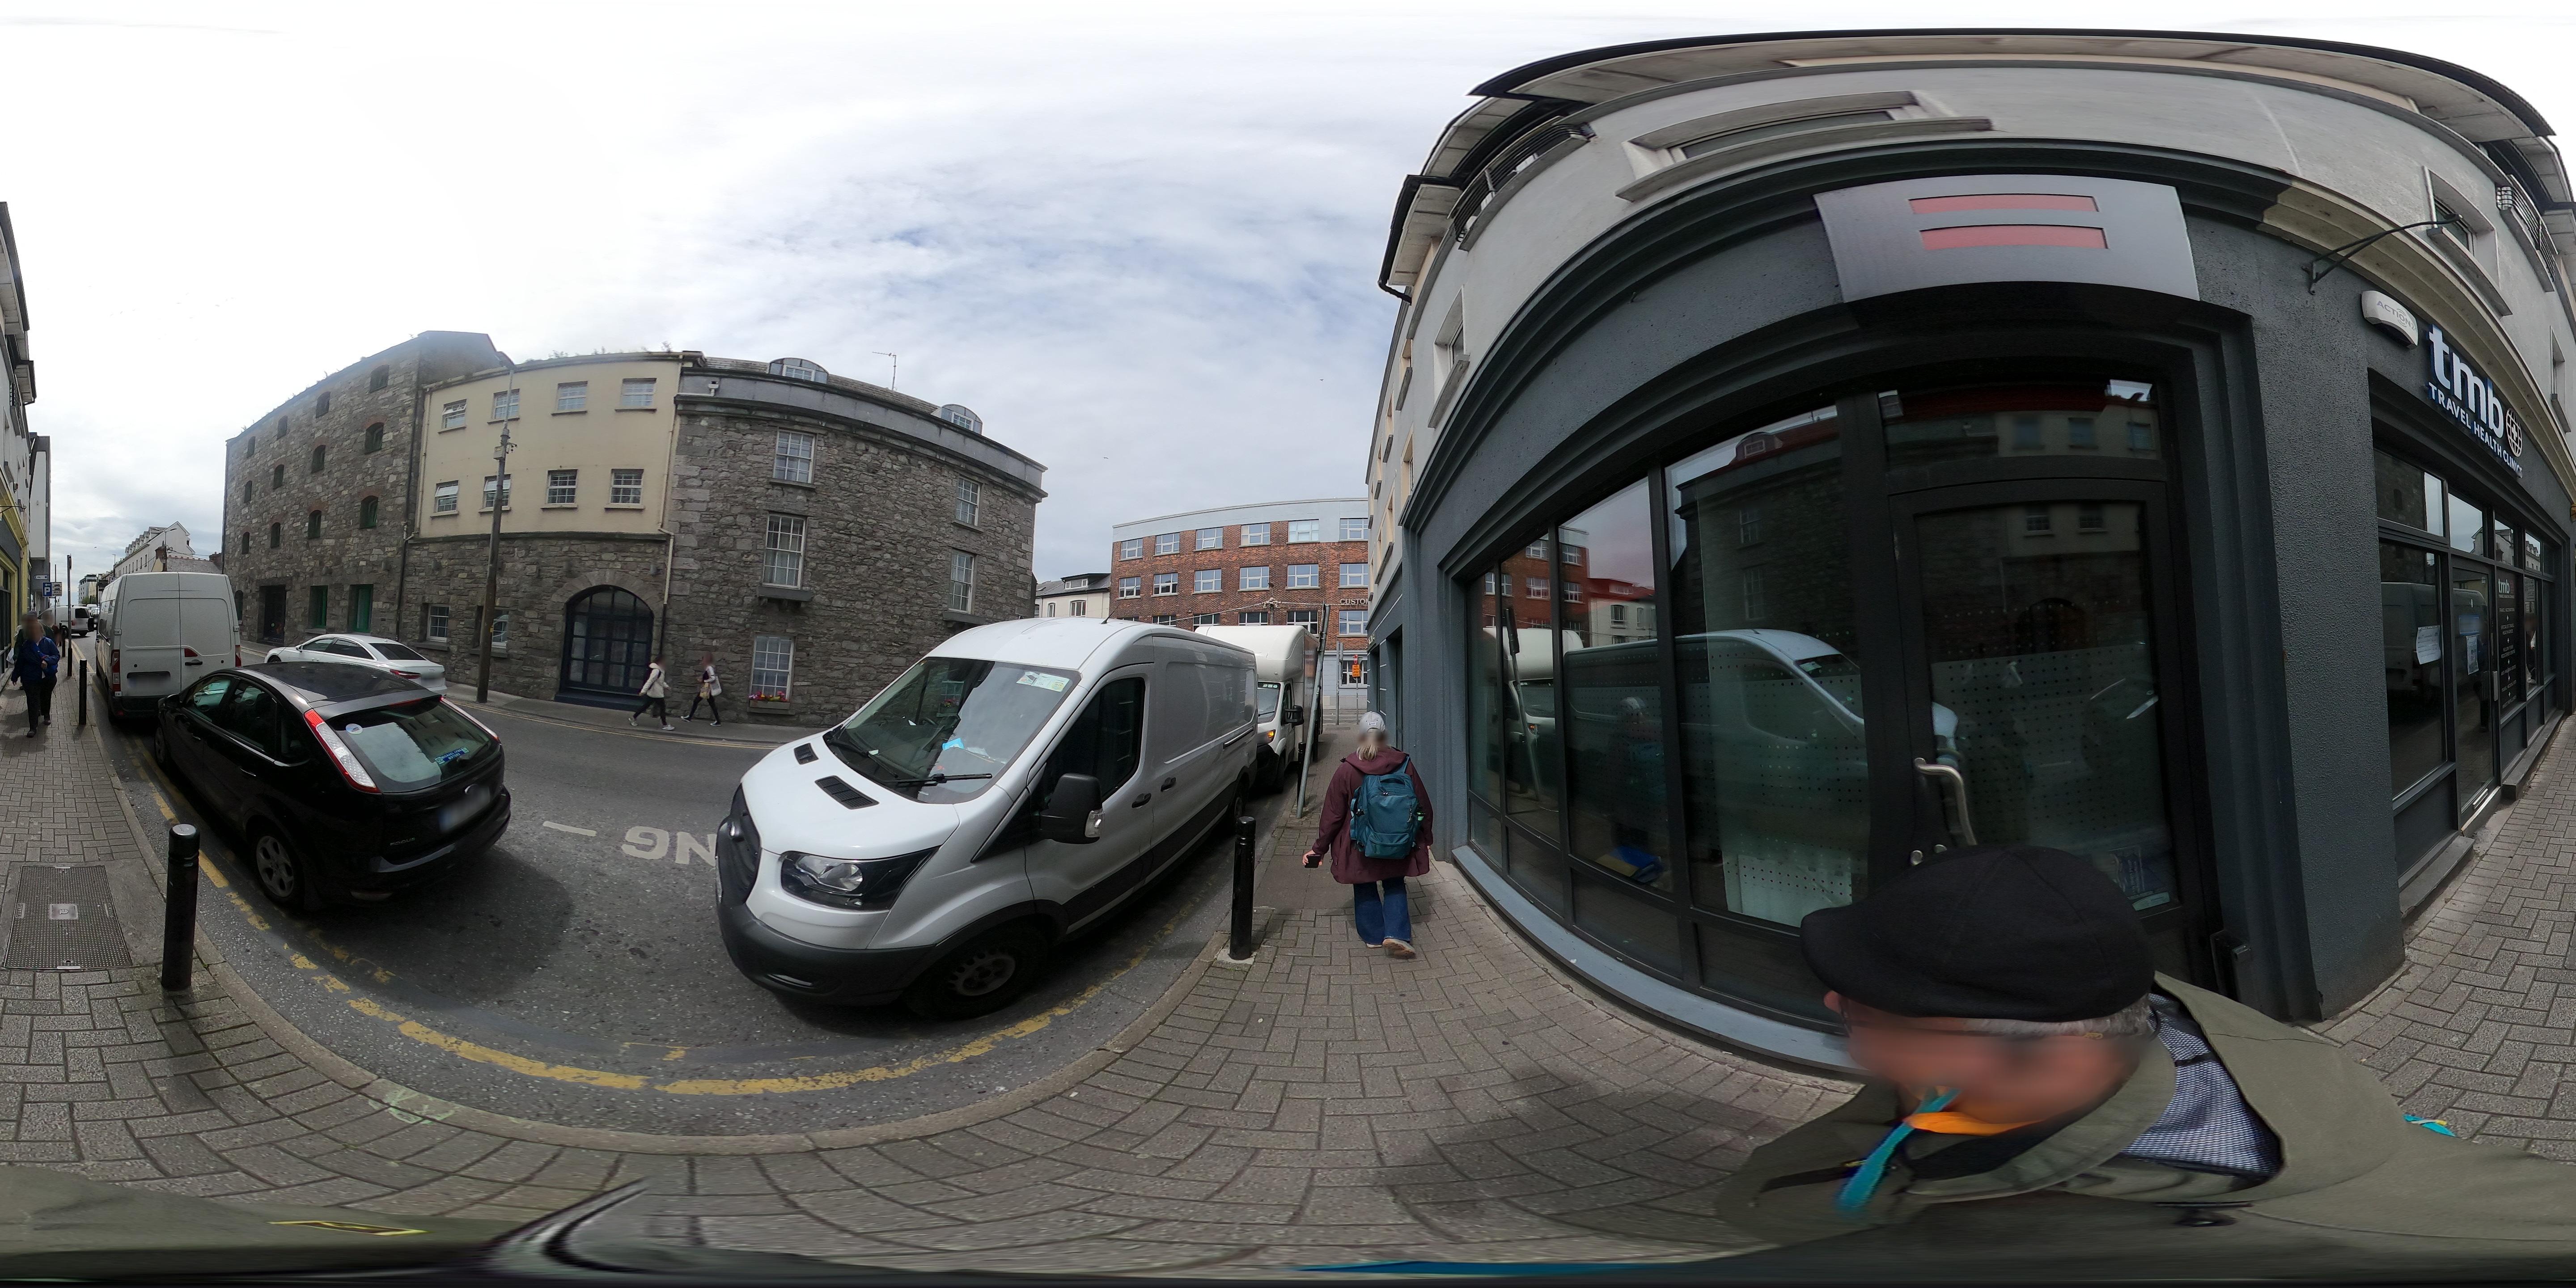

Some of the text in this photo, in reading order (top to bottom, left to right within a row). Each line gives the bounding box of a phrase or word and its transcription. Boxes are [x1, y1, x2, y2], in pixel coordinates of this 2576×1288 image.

[2428, 324, 2504, 438] tmb
[2428, 381, 2471, 429] TRAVEL
[2473, 421, 2502, 458] HEALTH
[44, 587, 51, 595] P
[2498, 578, 2510, 594] tmb
